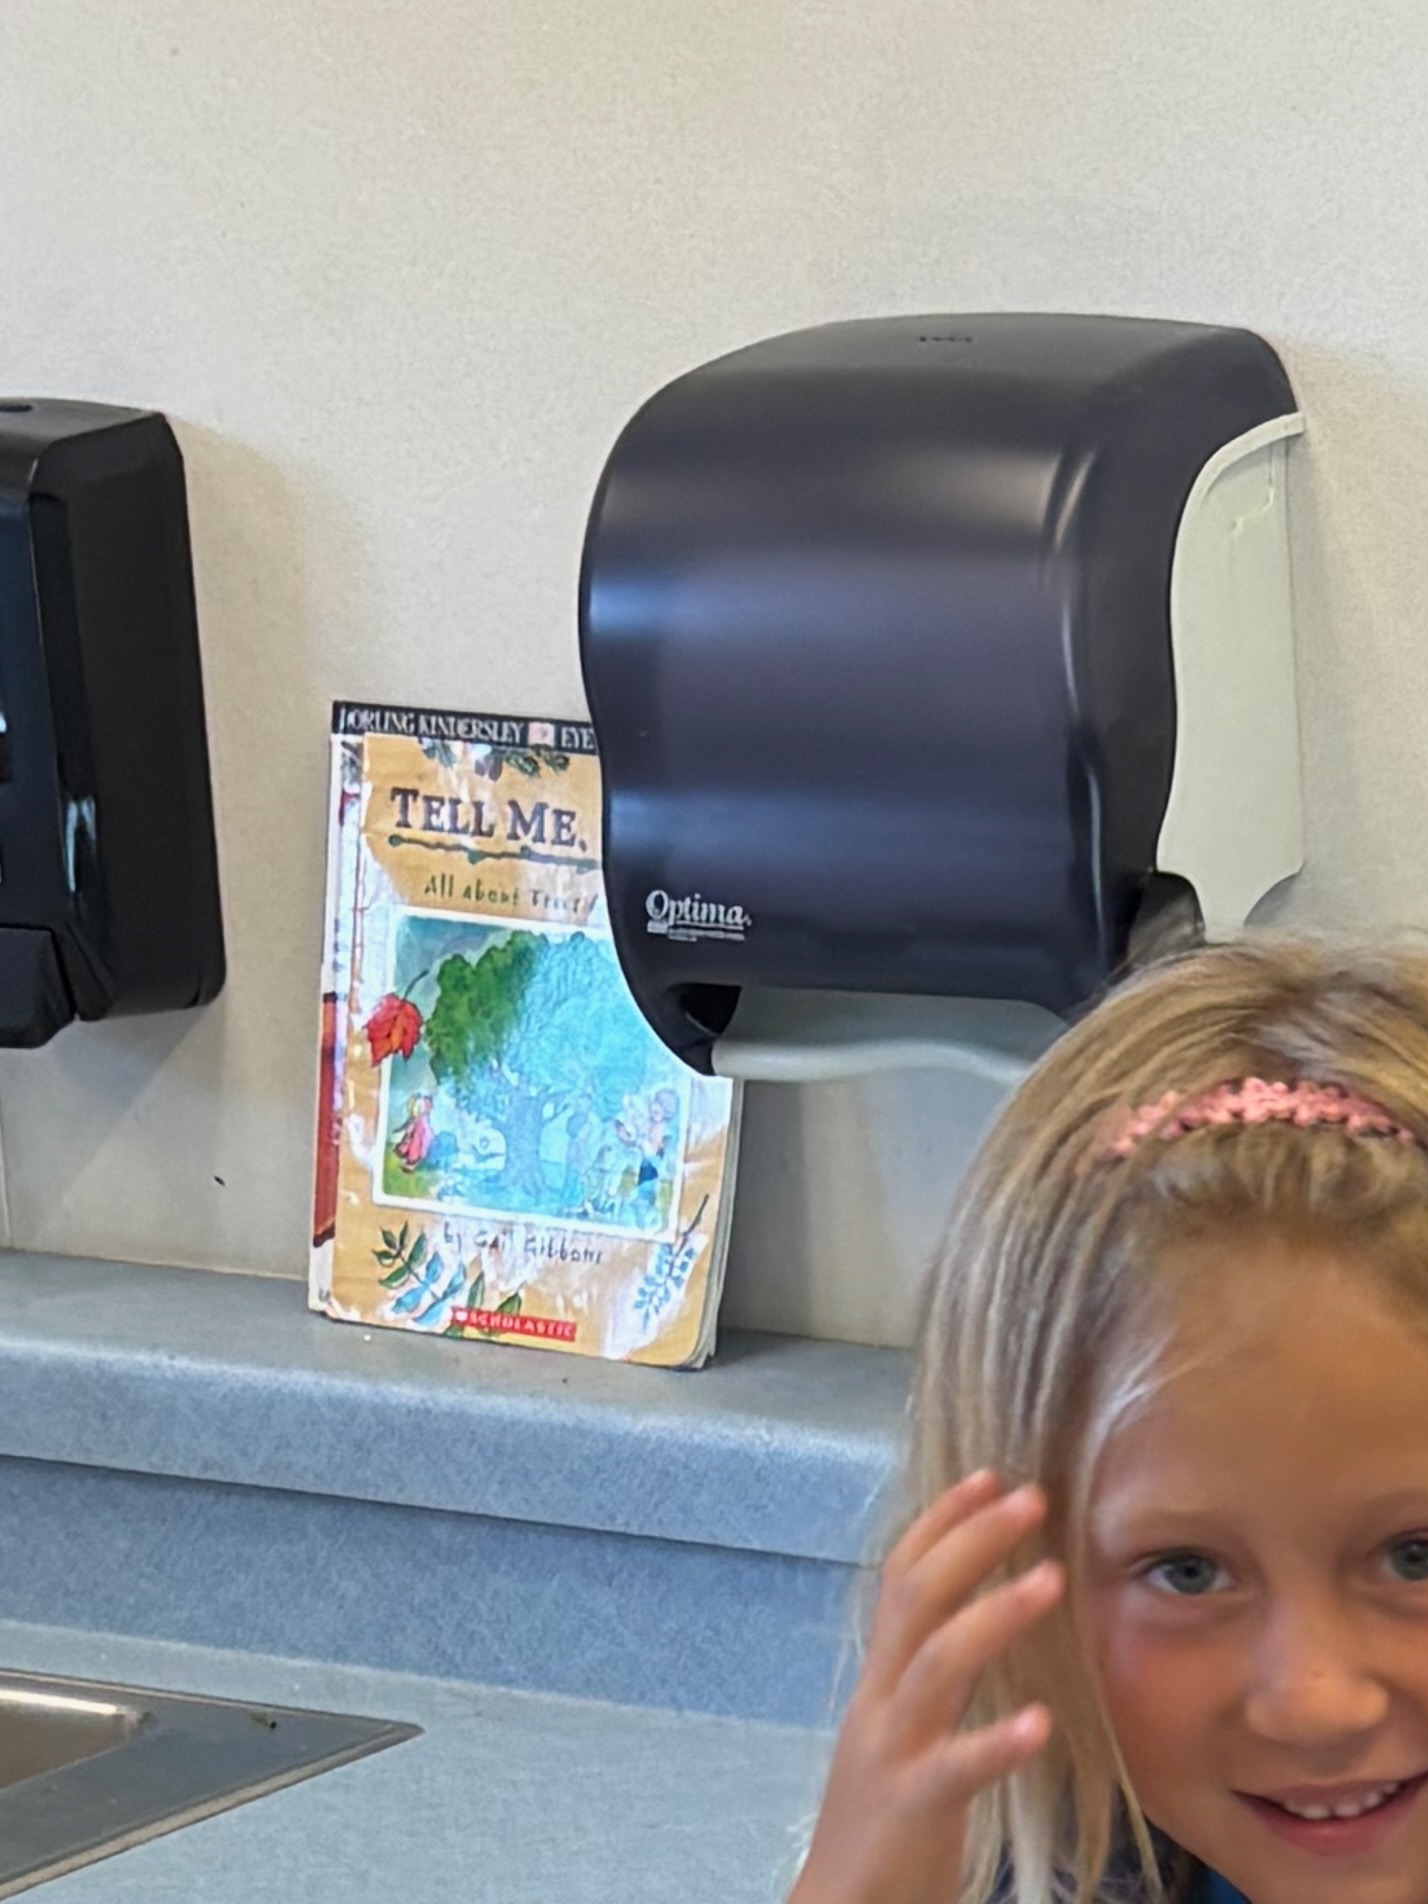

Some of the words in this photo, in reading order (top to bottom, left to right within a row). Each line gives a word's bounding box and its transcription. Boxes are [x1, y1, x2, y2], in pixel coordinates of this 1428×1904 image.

[417, 713, 524, 744] KINDERSLEY
[390, 786, 495, 838] TELL
[423, 872, 455, 898] All
[462, 878, 520, 907] about
[644, 888, 745, 926] Optima
[469, 1311, 574, 1339] SCHOLASTIC
